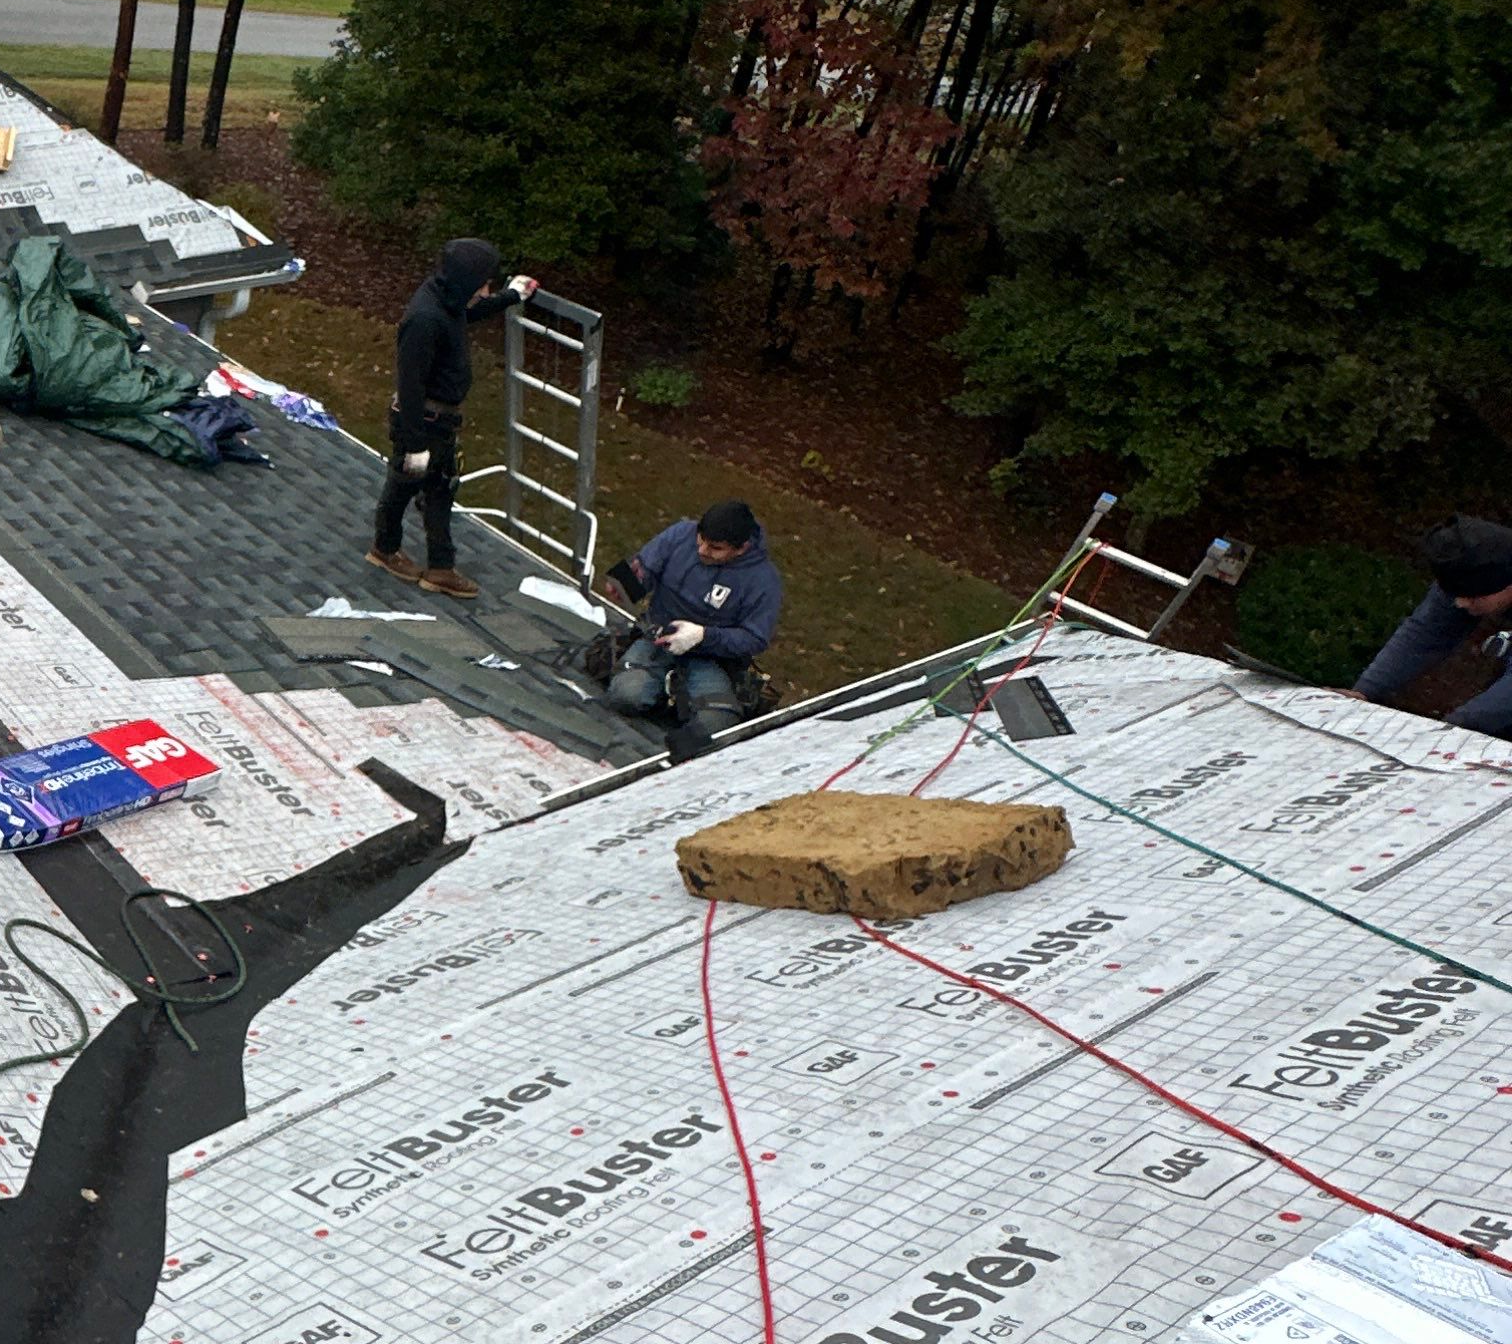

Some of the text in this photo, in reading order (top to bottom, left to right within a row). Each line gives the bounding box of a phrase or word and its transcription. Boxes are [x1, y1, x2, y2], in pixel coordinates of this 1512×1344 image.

[125, 737, 187, 768] GAF
[187, 710, 315, 818] FeltBuster
[331, 928, 545, 1013] FeltBuster
[654, 1015, 703, 1040] GAF
[807, 1050, 861, 1073] GAF
[1317, 1059, 1403, 1111] Synthetic
[1396, 1023, 1467, 1064] Roofing
[292, 1068, 571, 1209] FeltBuster
[332, 1169, 424, 1220] Synthetic
[423, 1131, 498, 1173] Roofing
[1143, 1148, 1213, 1184] GAF
[420, 1111, 725, 1272] FeltBuster
[471, 1226, 572, 1282] Synthetic
[566, 1182, 650, 1230] Roofing
[644, 1166, 678, 1186] Felt
[973, 1315, 1024, 1344] Felt
